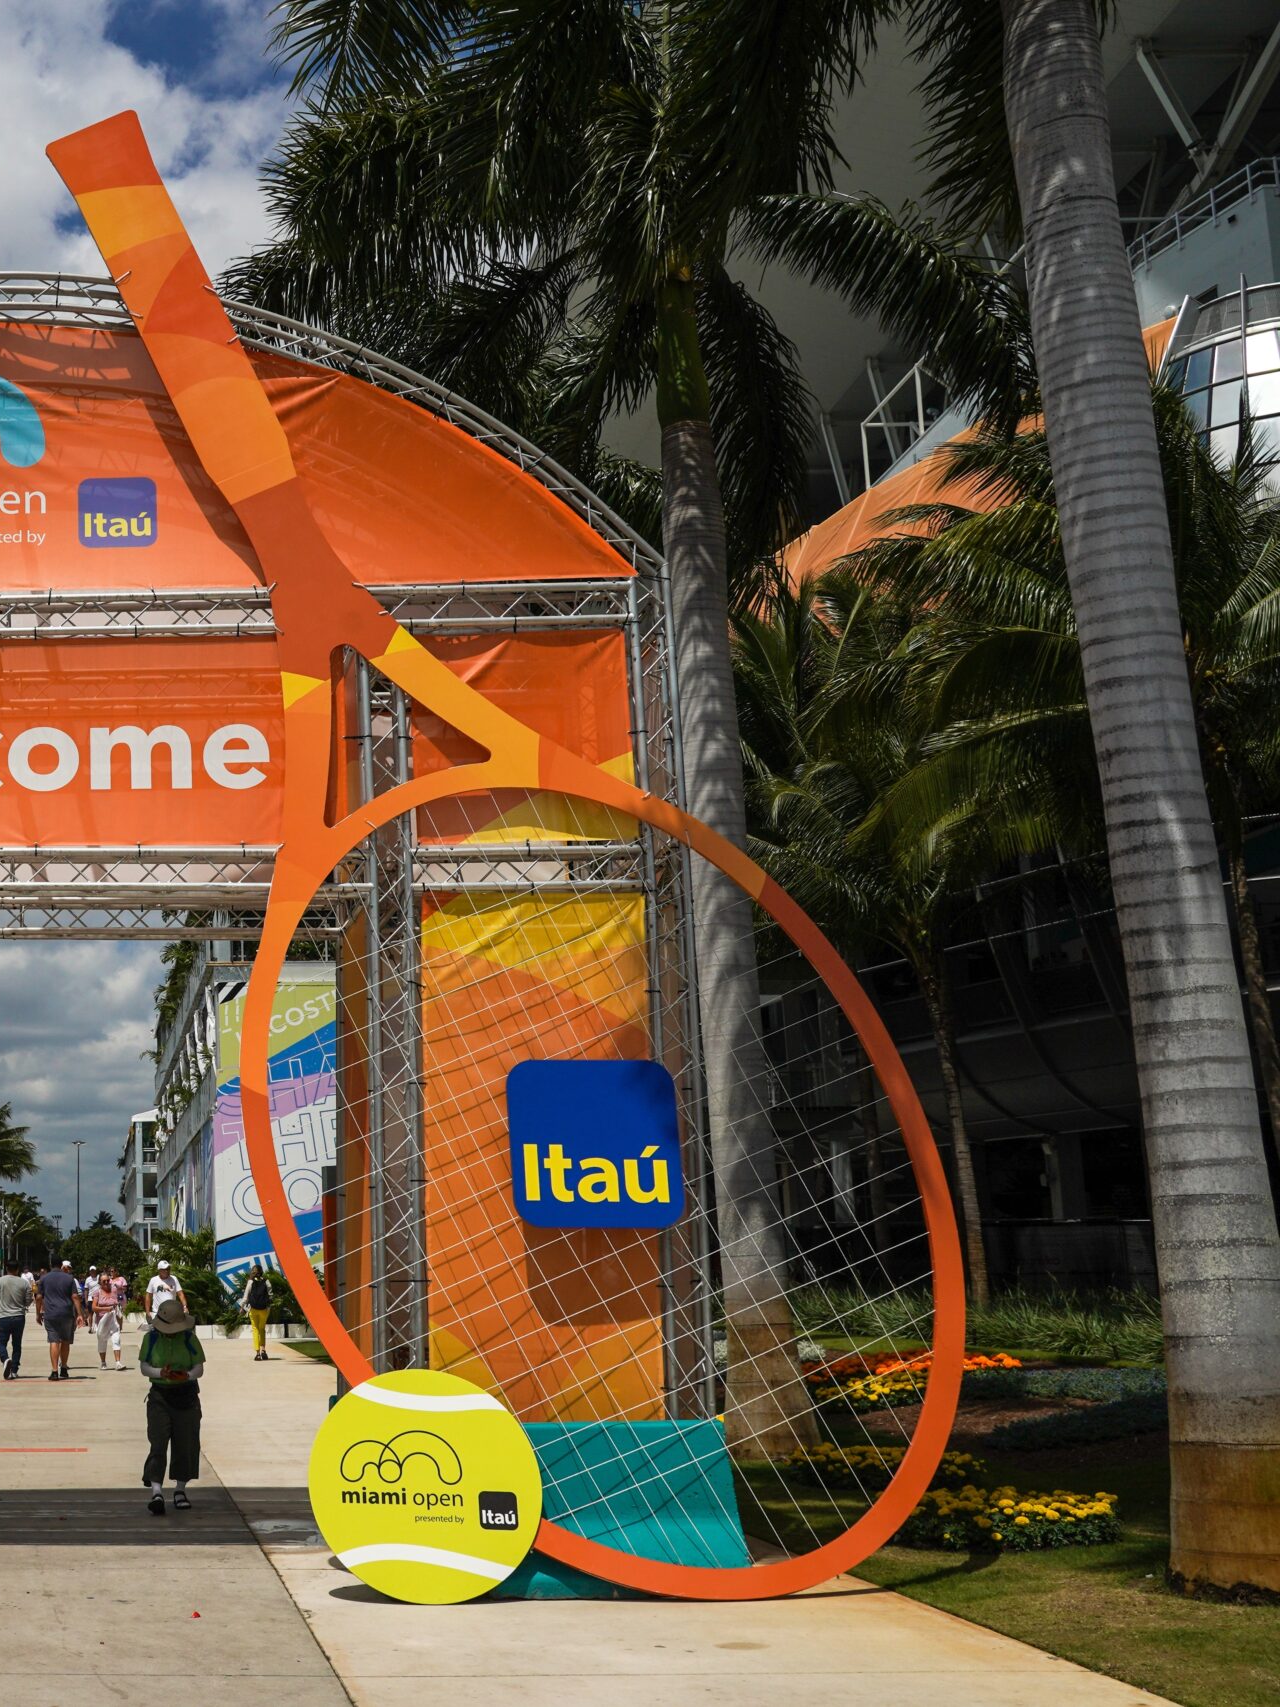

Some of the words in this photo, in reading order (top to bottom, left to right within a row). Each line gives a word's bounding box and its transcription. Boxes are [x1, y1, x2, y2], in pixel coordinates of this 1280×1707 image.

[84, 511, 153, 537] Itaú
[28, 529, 47, 546] by
[522, 1143, 671, 1204] Itaú
[341, 1487, 407, 1506] miami
[413, 1491, 463, 1510] open
[414, 1514, 454, 1524] presented
[455, 1515, 464, 1524] by
[481, 1509, 516, 1525] Itaú
